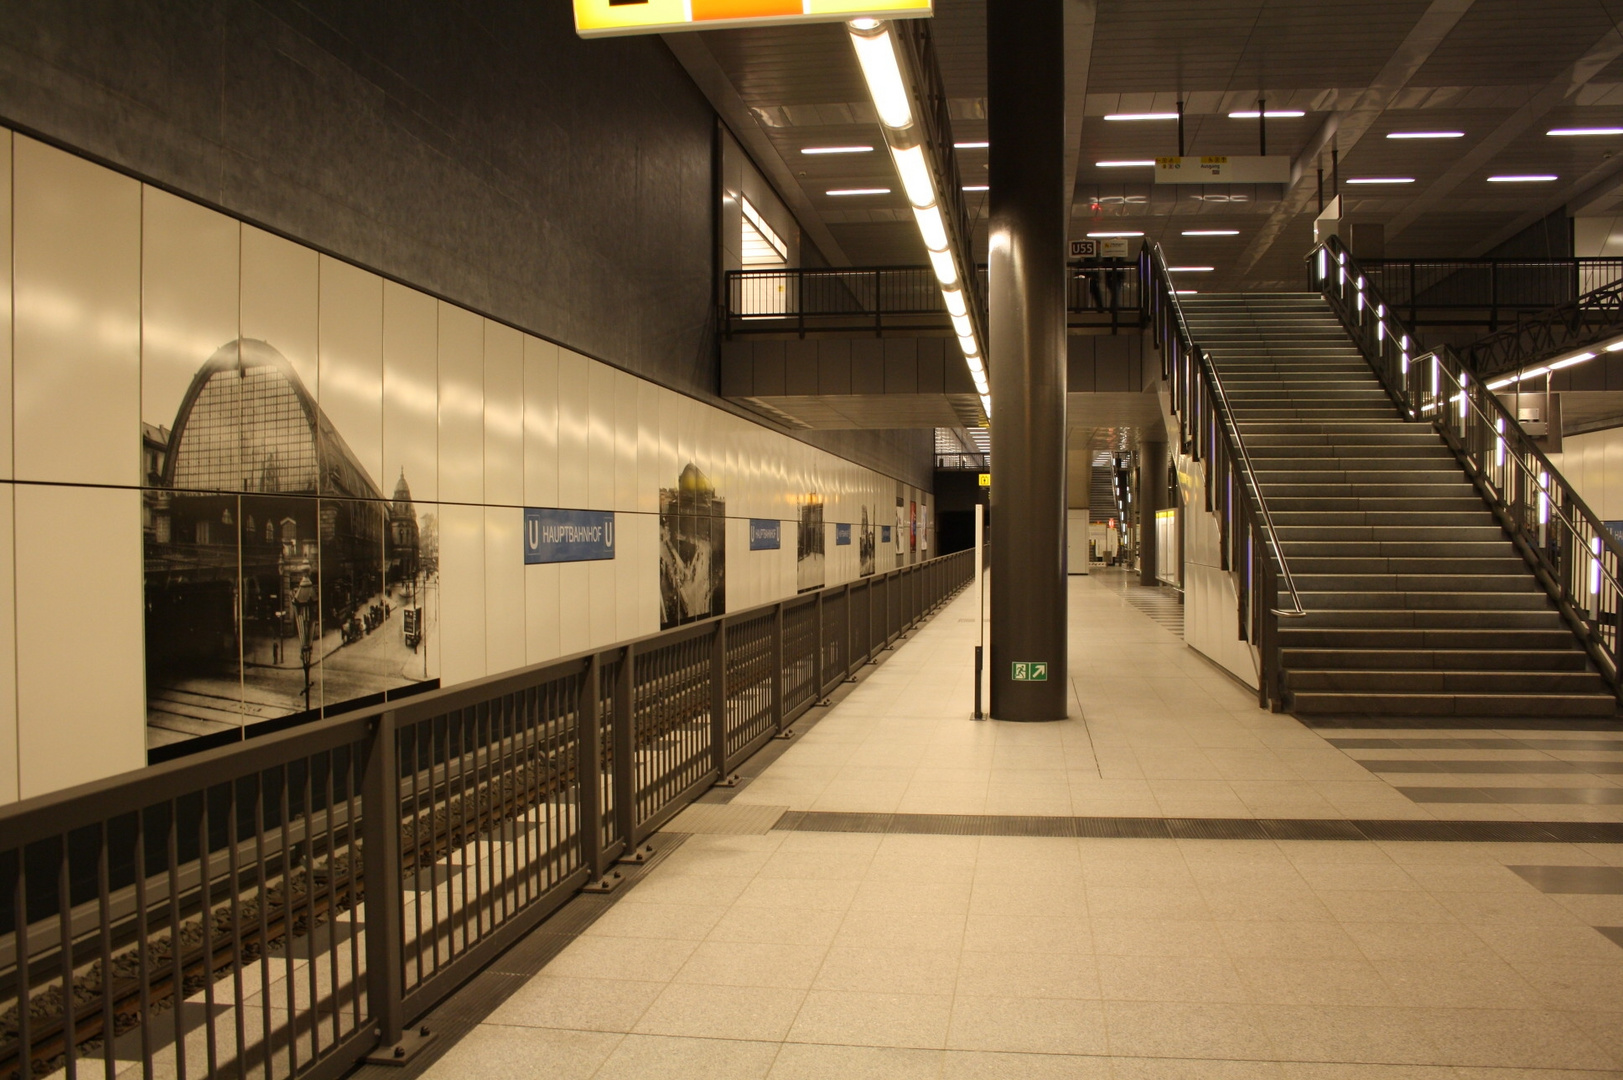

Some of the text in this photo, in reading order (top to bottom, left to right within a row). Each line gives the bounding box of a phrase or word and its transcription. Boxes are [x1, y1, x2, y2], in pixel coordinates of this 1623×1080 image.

[529, 519, 613, 550] U HAUPTBAHNHOF U
